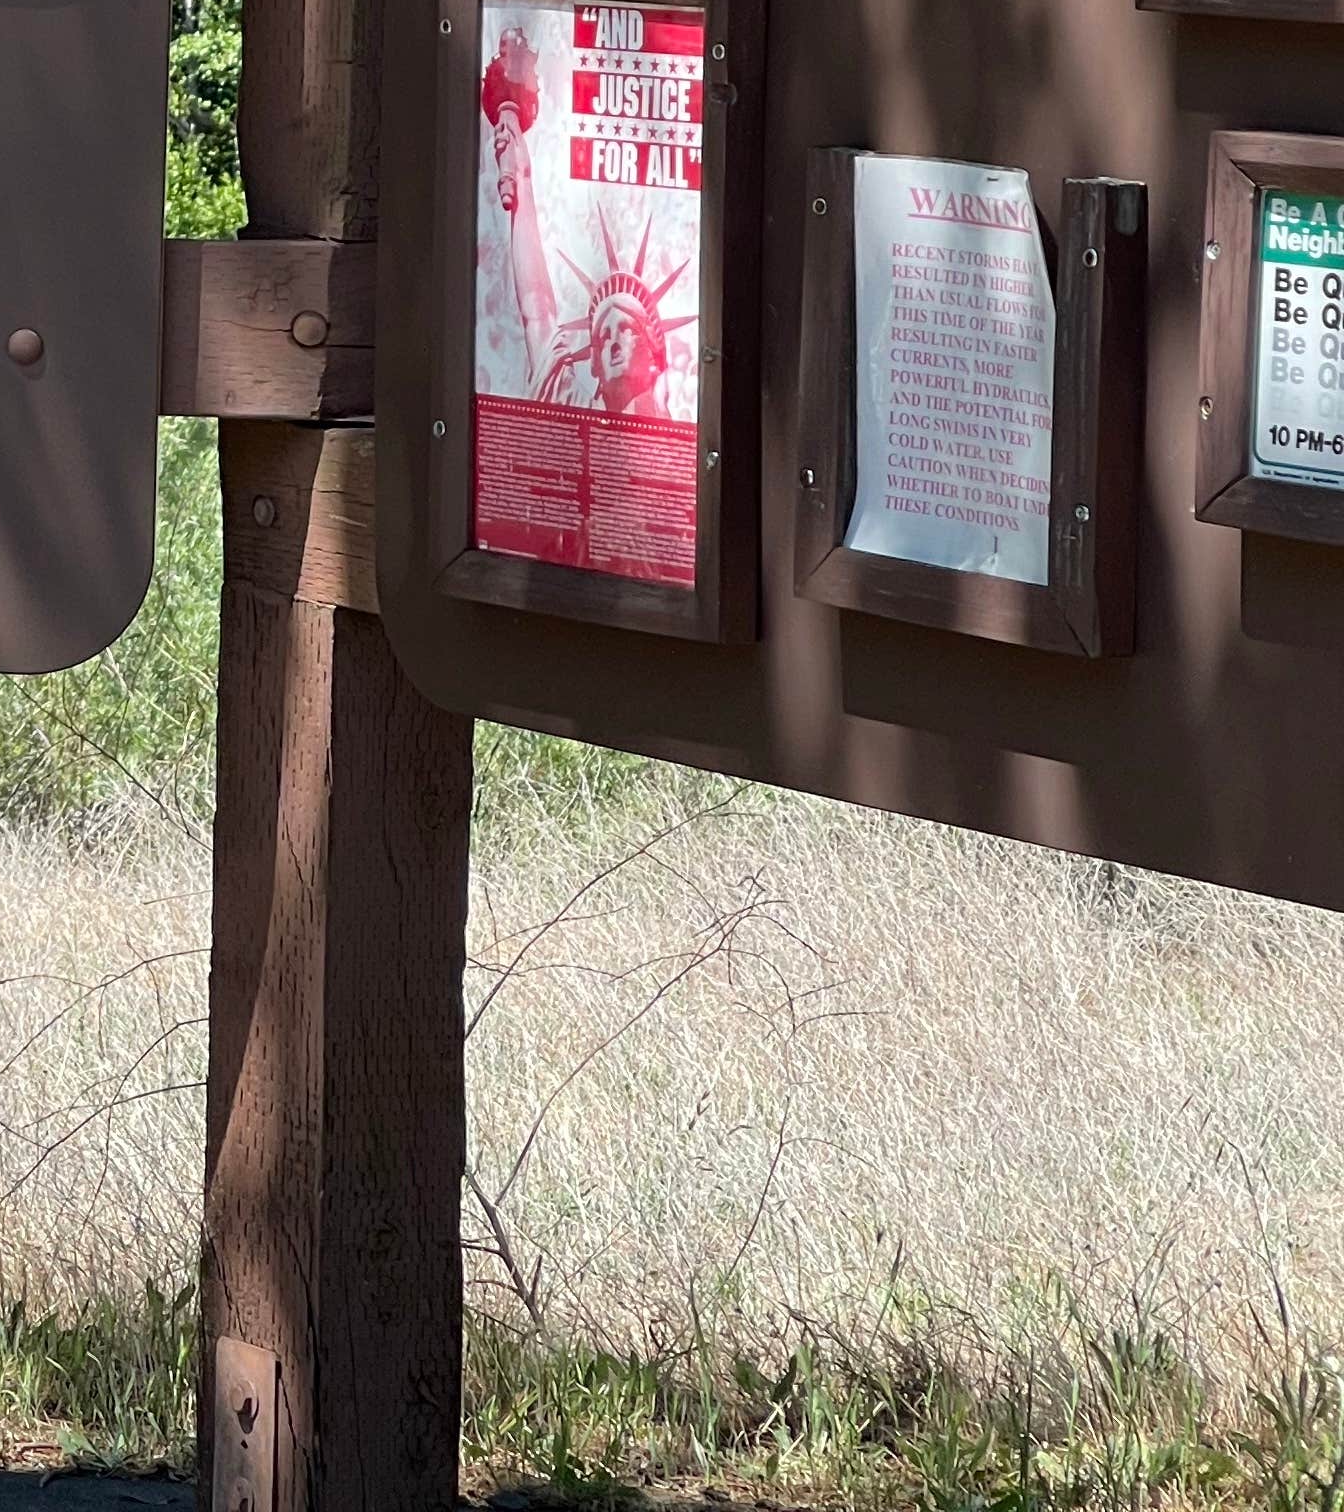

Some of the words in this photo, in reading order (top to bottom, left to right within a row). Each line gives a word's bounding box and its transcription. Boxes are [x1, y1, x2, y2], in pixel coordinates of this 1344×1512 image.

[592, 73, 692, 121] JUSTICE
[591, 140, 638, 184] FOR
[909, 186, 1032, 229] WARNING
[1271, 198, 1301, 224] Be
[1310, 201, 1328, 226] A
[892, 243, 957, 263] RECENT
[958, 250, 1010, 271] STORMS
[892, 264, 970, 284] RESULTED
[973, 273, 986, 289] IN
[990, 276, 1034, 297] HIGHER
[1274, 267, 1309, 295] Be
[894, 285, 936, 301] THAN
[940, 291, 985, 310] USUAL
[986, 299, 1029, 318] FLOWS
[1274, 297, 1308, 325] Be
[894, 306, 927, 323] THIS
[932, 310, 966, 329] TIME
[969, 316, 988, 332] OF
[991, 319, 1015, 337] THE
[1016, 324, 1045, 344] YEAR
[1272, 327, 1306, 355] Be
[891, 327, 972, 352] RESULTING
[976, 339, 992, 354] IN
[994, 342, 1038, 362] FASTER
[890, 348, 970, 376] CURRENTS,
[974, 359, 1015, 380] MORE
[1270, 356, 1305, 384] Be
[890, 370, 971, 395] POWERFUL
[890, 391, 921, 407] AND
[925, 395, 952, 413] THE
[955, 400, 1029, 426] POTENTIAL
[1032, 413, 1052, 431] FOR
[889, 411, 931, 430] LONG
[934, 418, 980, 438] SWIMS
[982, 426, 998, 441] IN
[1001, 428, 1033, 449] VERY
[1269, 424, 1290, 447] 10
[888, 432, 929, 451] COLD
[933, 438, 985, 460] WATER.
[989, 448, 1014, 466] USE
[888, 453, 952, 476] CAUTION
[956, 462, 998, 485] WHEN
[1000, 471, 1050, 495] DECIDIN
[887, 473, 959, 499] WHETHER
[963, 487, 983, 502] TO
[985, 492, 1021, 510] BOAT
[884, 494, 931, 516] THESE
[934, 503, 1021, 532] CONDITIONS
